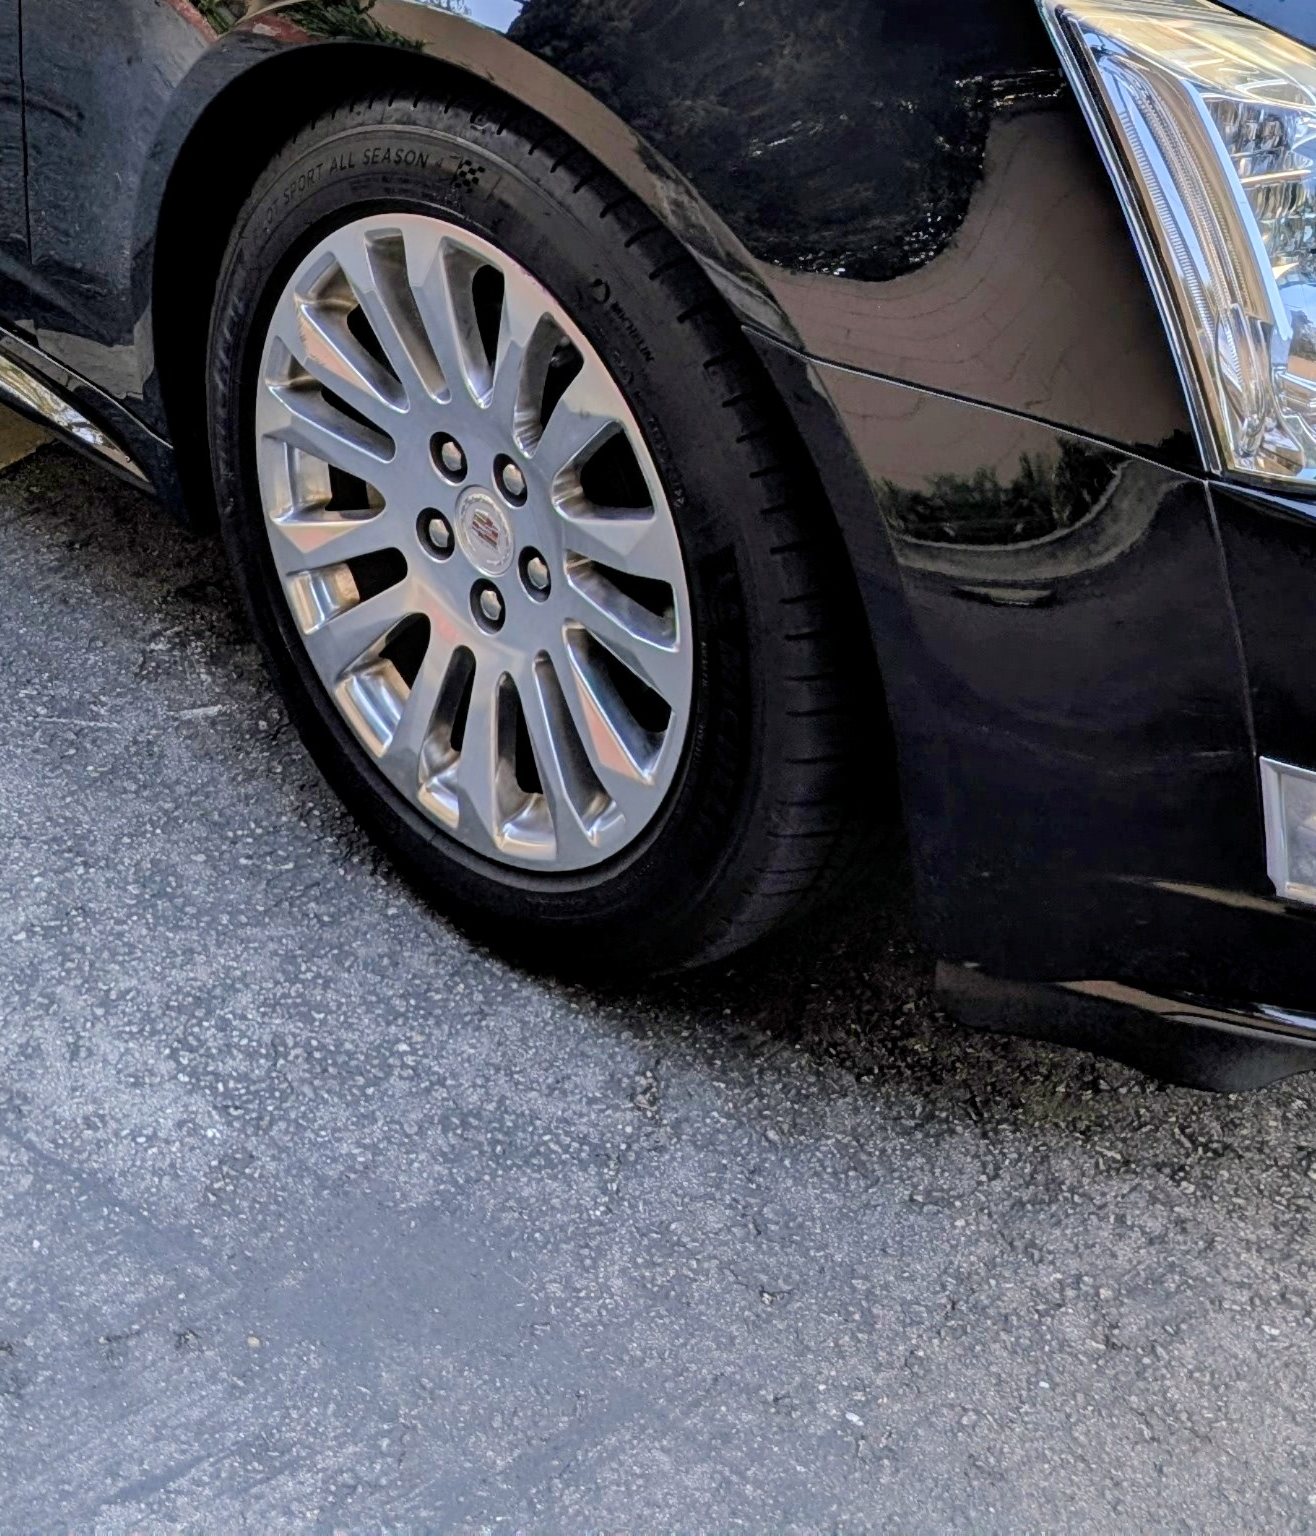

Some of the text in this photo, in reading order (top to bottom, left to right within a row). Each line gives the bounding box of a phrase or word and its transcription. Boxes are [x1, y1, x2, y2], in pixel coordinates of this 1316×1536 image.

[283, 161, 324, 205] SPORT
[329, 153, 356, 174] ALL
[362, 147, 430, 168] SEASON
